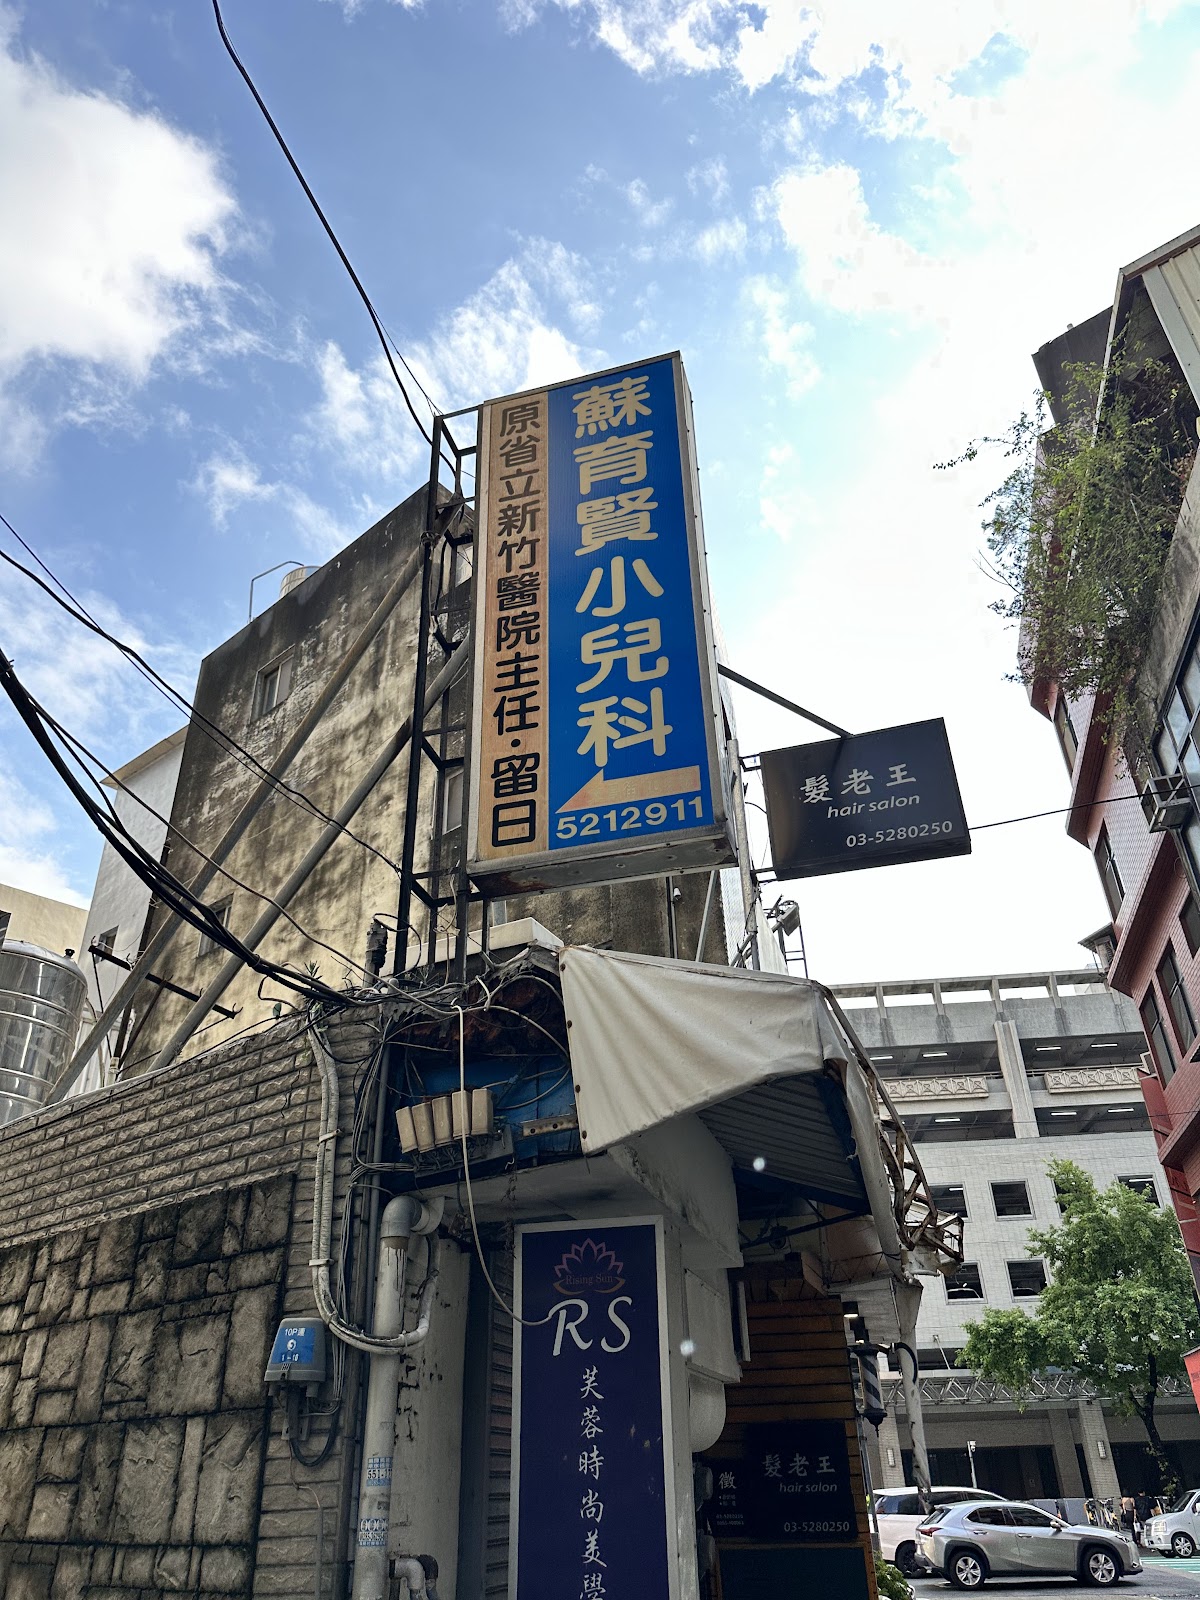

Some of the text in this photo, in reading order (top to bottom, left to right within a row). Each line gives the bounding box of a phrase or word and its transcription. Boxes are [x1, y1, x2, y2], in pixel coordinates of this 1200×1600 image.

[572, 374, 673, 767] 蘇育賢小兒科
[800, 763, 918, 804] 髮老王
[555, 795, 705, 840] 5212911
[827, 794, 921, 819] hair salon
[845, 820, 953, 849] 03-5280250
[762, 1453, 836, 1478] 髮老王
[578, 1365, 607, 1600] 芙蓉時尚美學
[779, 1482, 838, 1493] hair salon
[784, 1520, 851, 1533] 03-5280250
